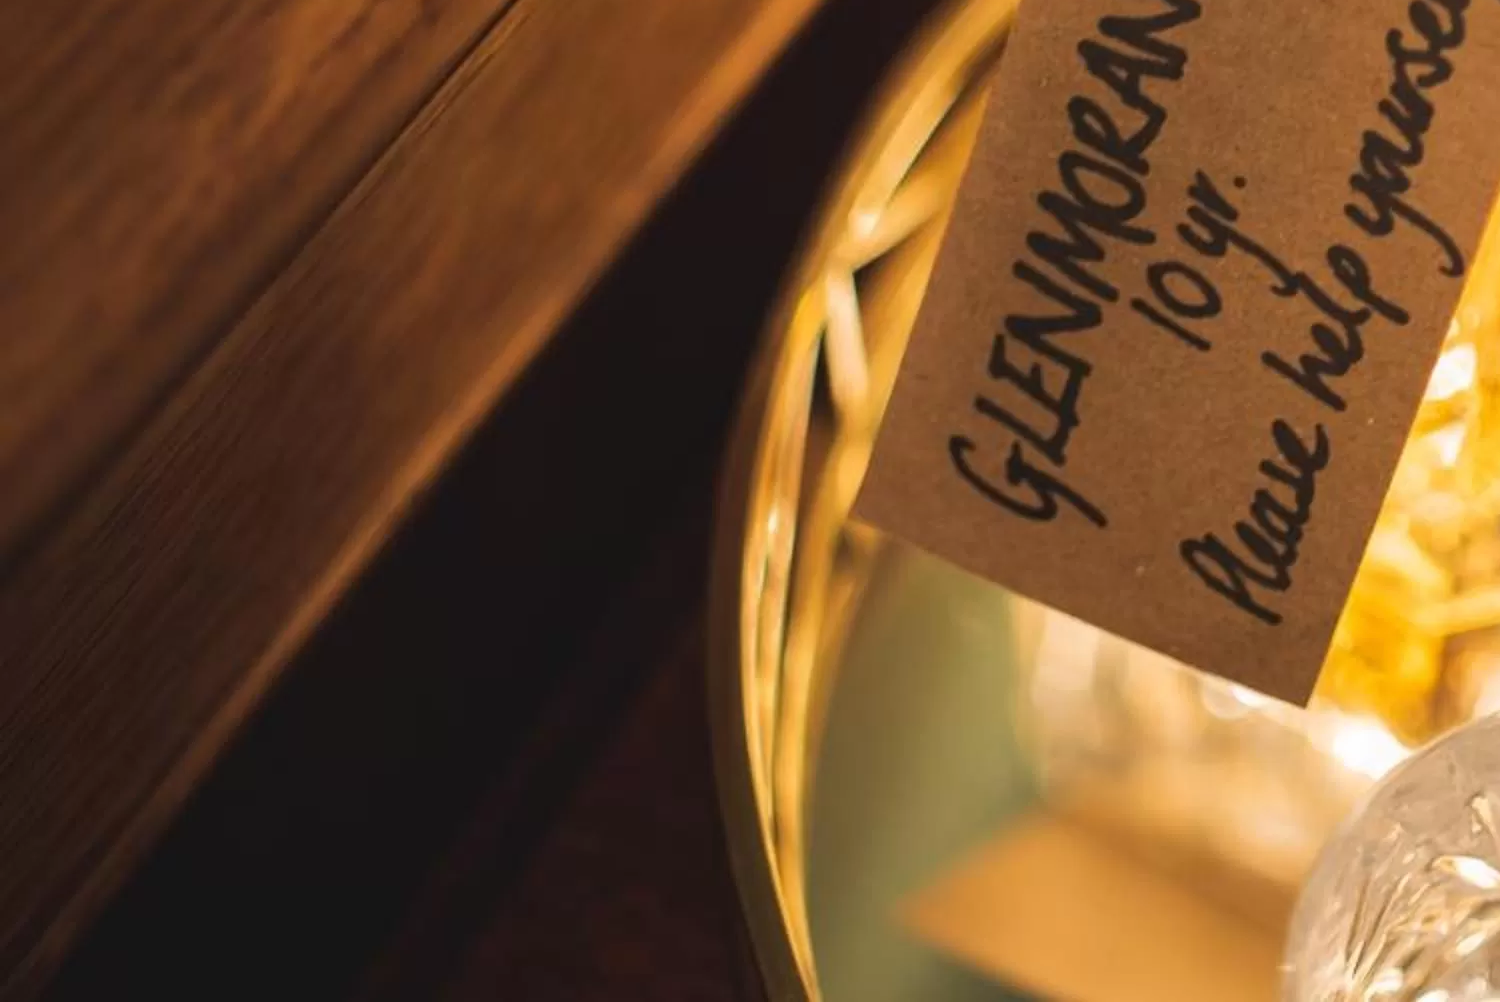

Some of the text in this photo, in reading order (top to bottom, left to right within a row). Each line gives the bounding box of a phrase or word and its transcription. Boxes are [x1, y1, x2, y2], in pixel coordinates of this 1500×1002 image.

[1131, 169, 1301, 351] 10 yr.
[1181, 418, 1332, 625] Please
[1262, 244, 1410, 411] help
